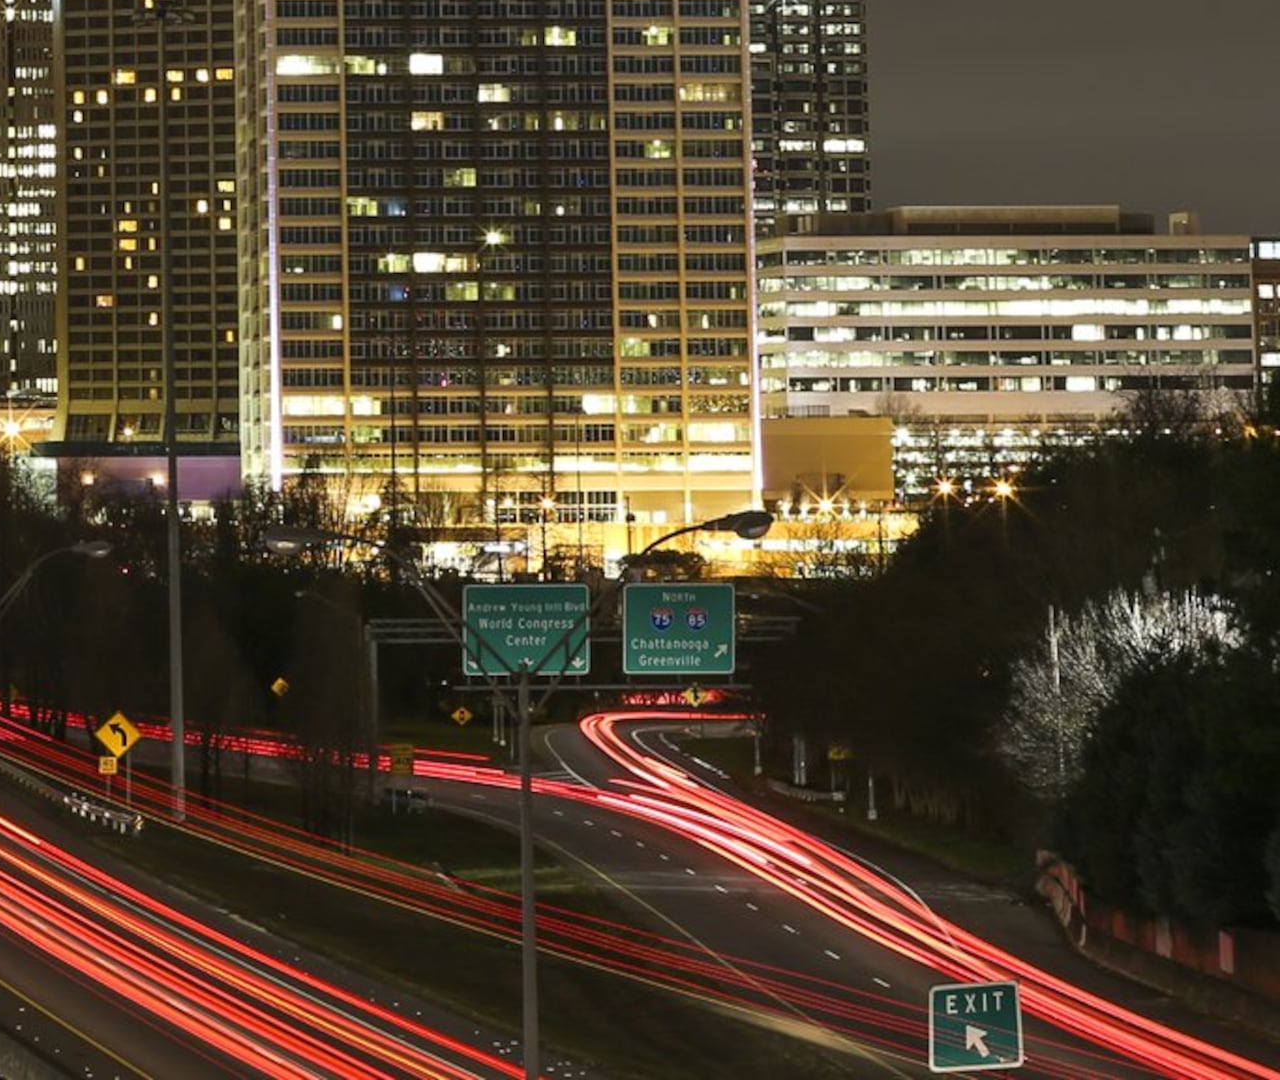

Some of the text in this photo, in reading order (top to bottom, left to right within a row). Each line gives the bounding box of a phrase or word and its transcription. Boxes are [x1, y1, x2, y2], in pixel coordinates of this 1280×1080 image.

[468, 602, 506, 612] Andrew
[511, 602, 542, 614] Young
[479, 618, 574, 632] World Congress
[654, 615, 705, 626] 75 85
[505, 635, 547, 647] Center
[631, 638, 709, 651] Chattanooga
[638, 654, 701, 667] Greenville
[946, 991, 1004, 1014] EXIT
